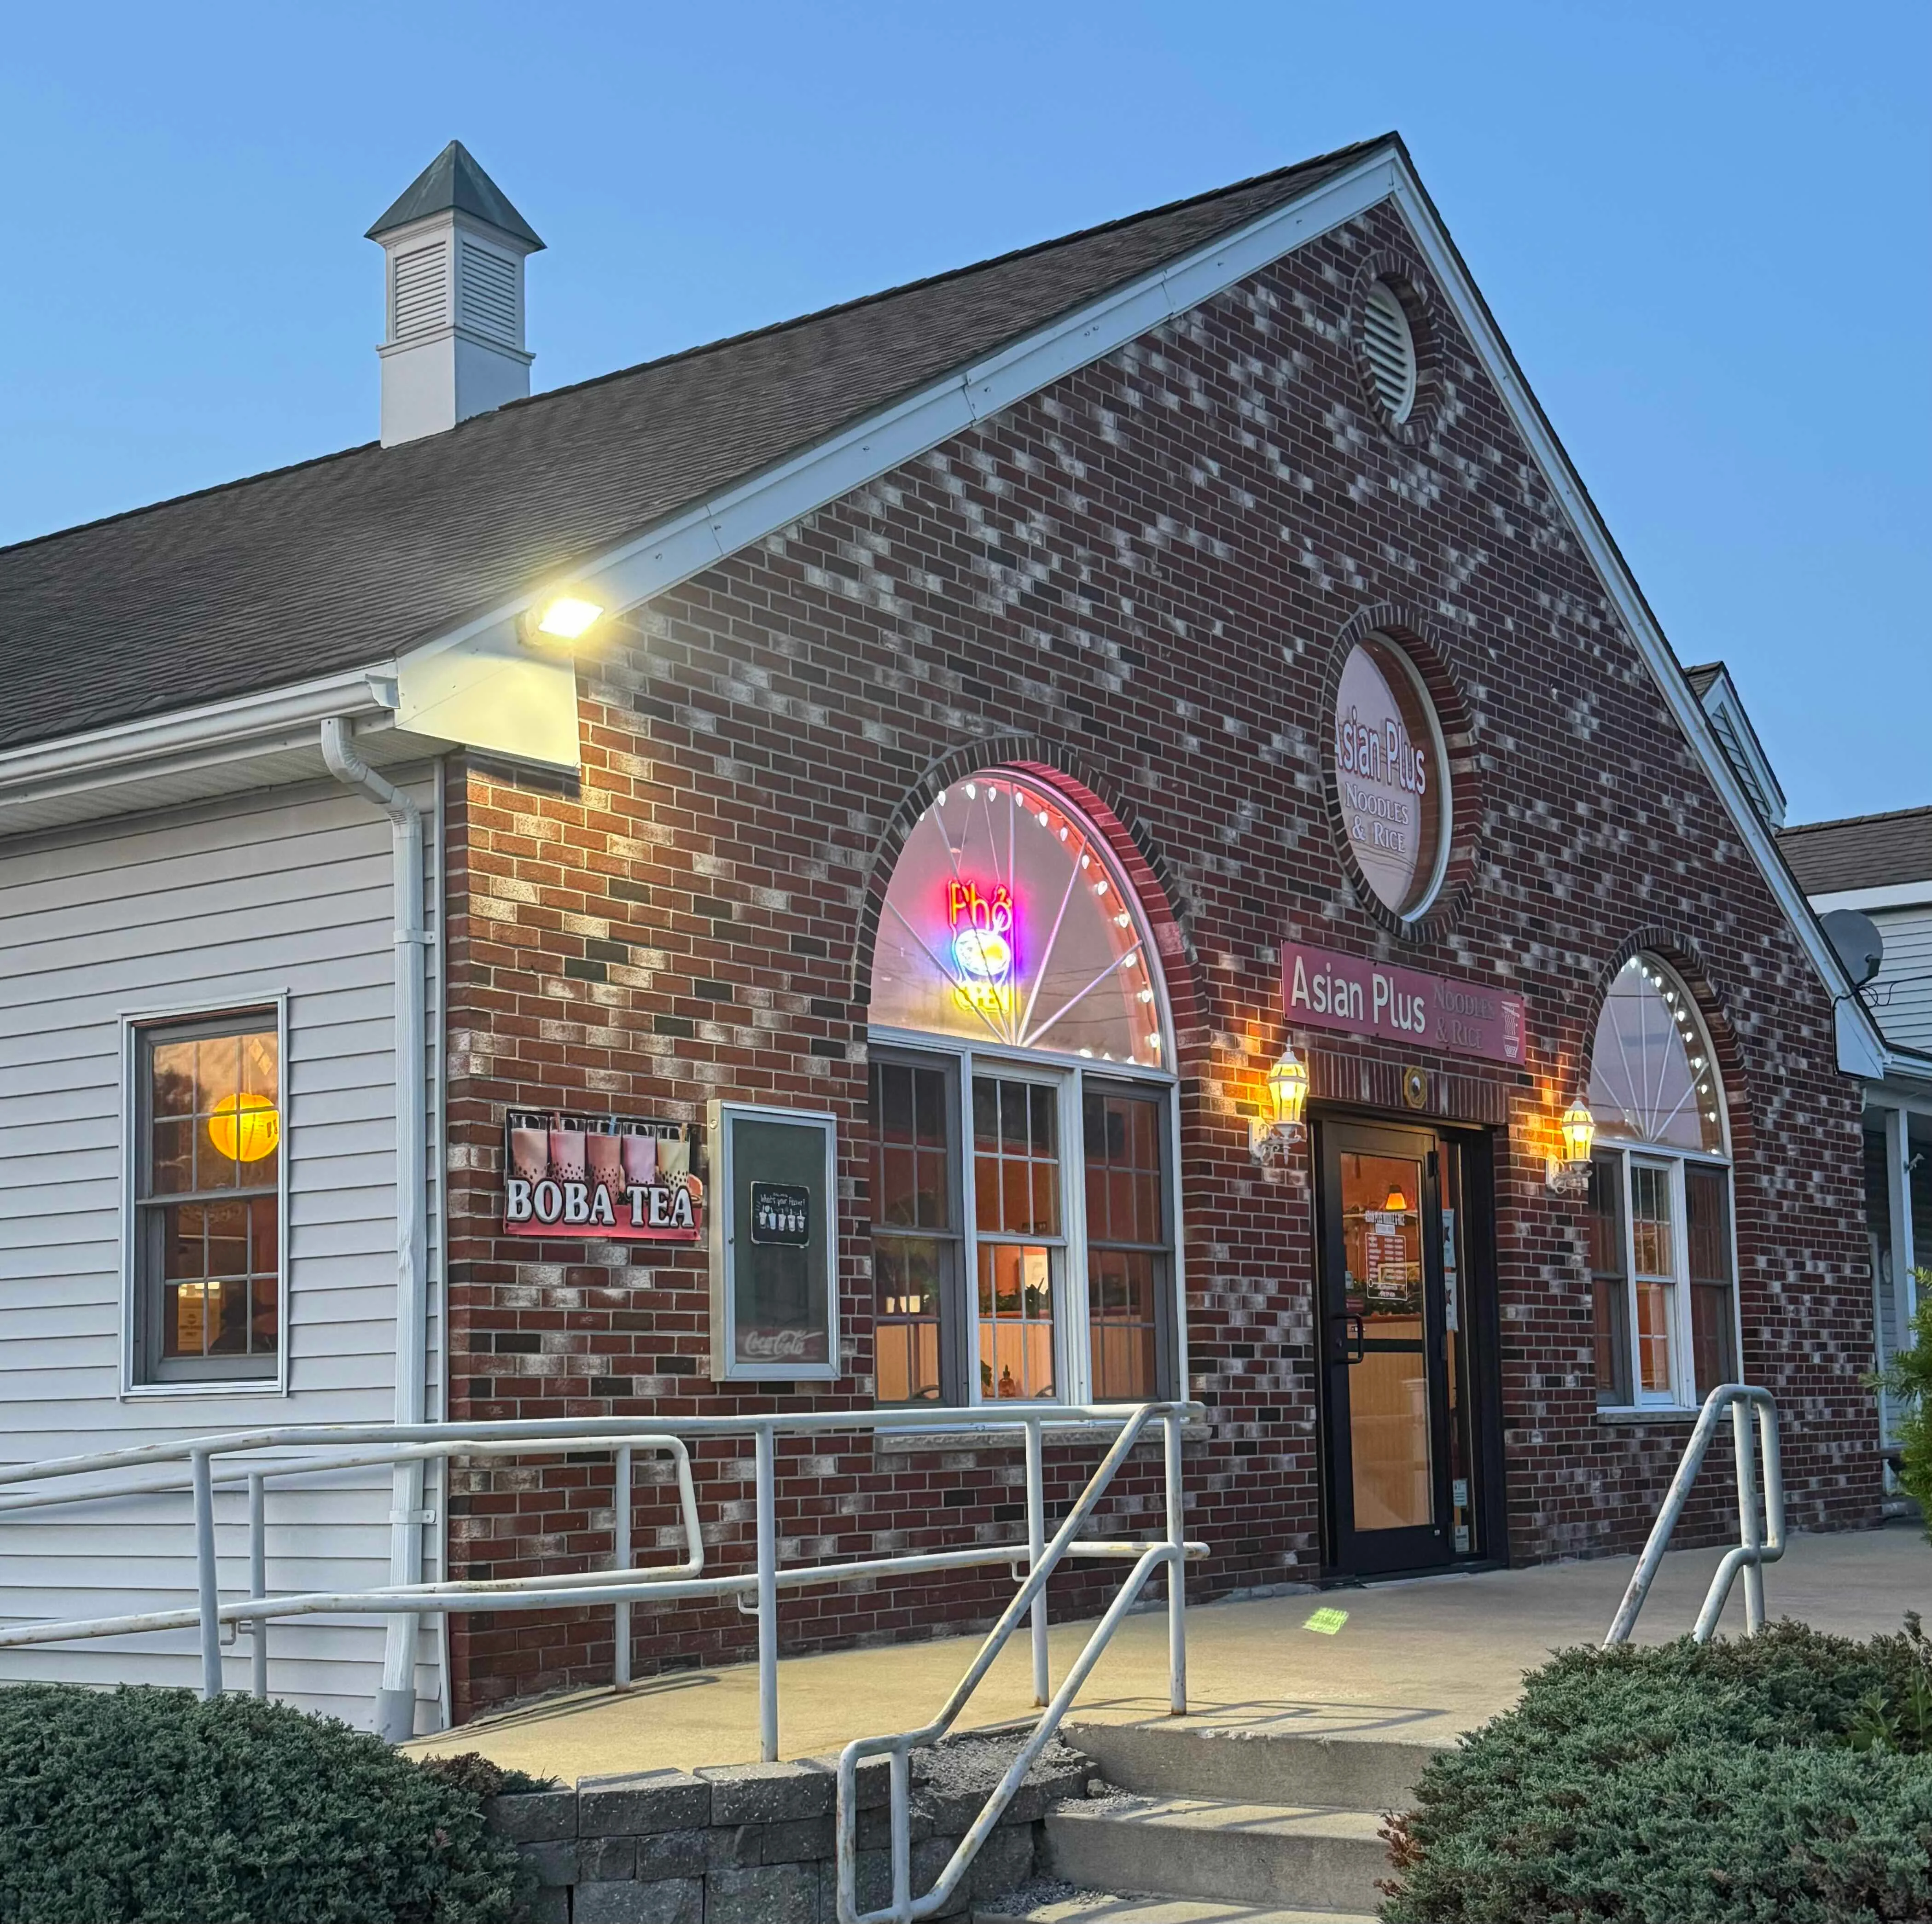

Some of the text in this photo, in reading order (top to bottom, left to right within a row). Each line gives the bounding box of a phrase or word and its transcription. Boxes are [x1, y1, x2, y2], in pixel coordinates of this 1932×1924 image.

[1385, 718, 1426, 796] Plus
[1345, 782, 1409, 825] NOODLES
[1352, 815, 1406, 853] & RICE
[1291, 955, 1426, 1034] Asian Plus
[1433, 983, 1495, 1022] NOODLES
[1436, 1017, 1484, 1050] & RICE
[507, 1179, 695, 1228] BOBA TEA
